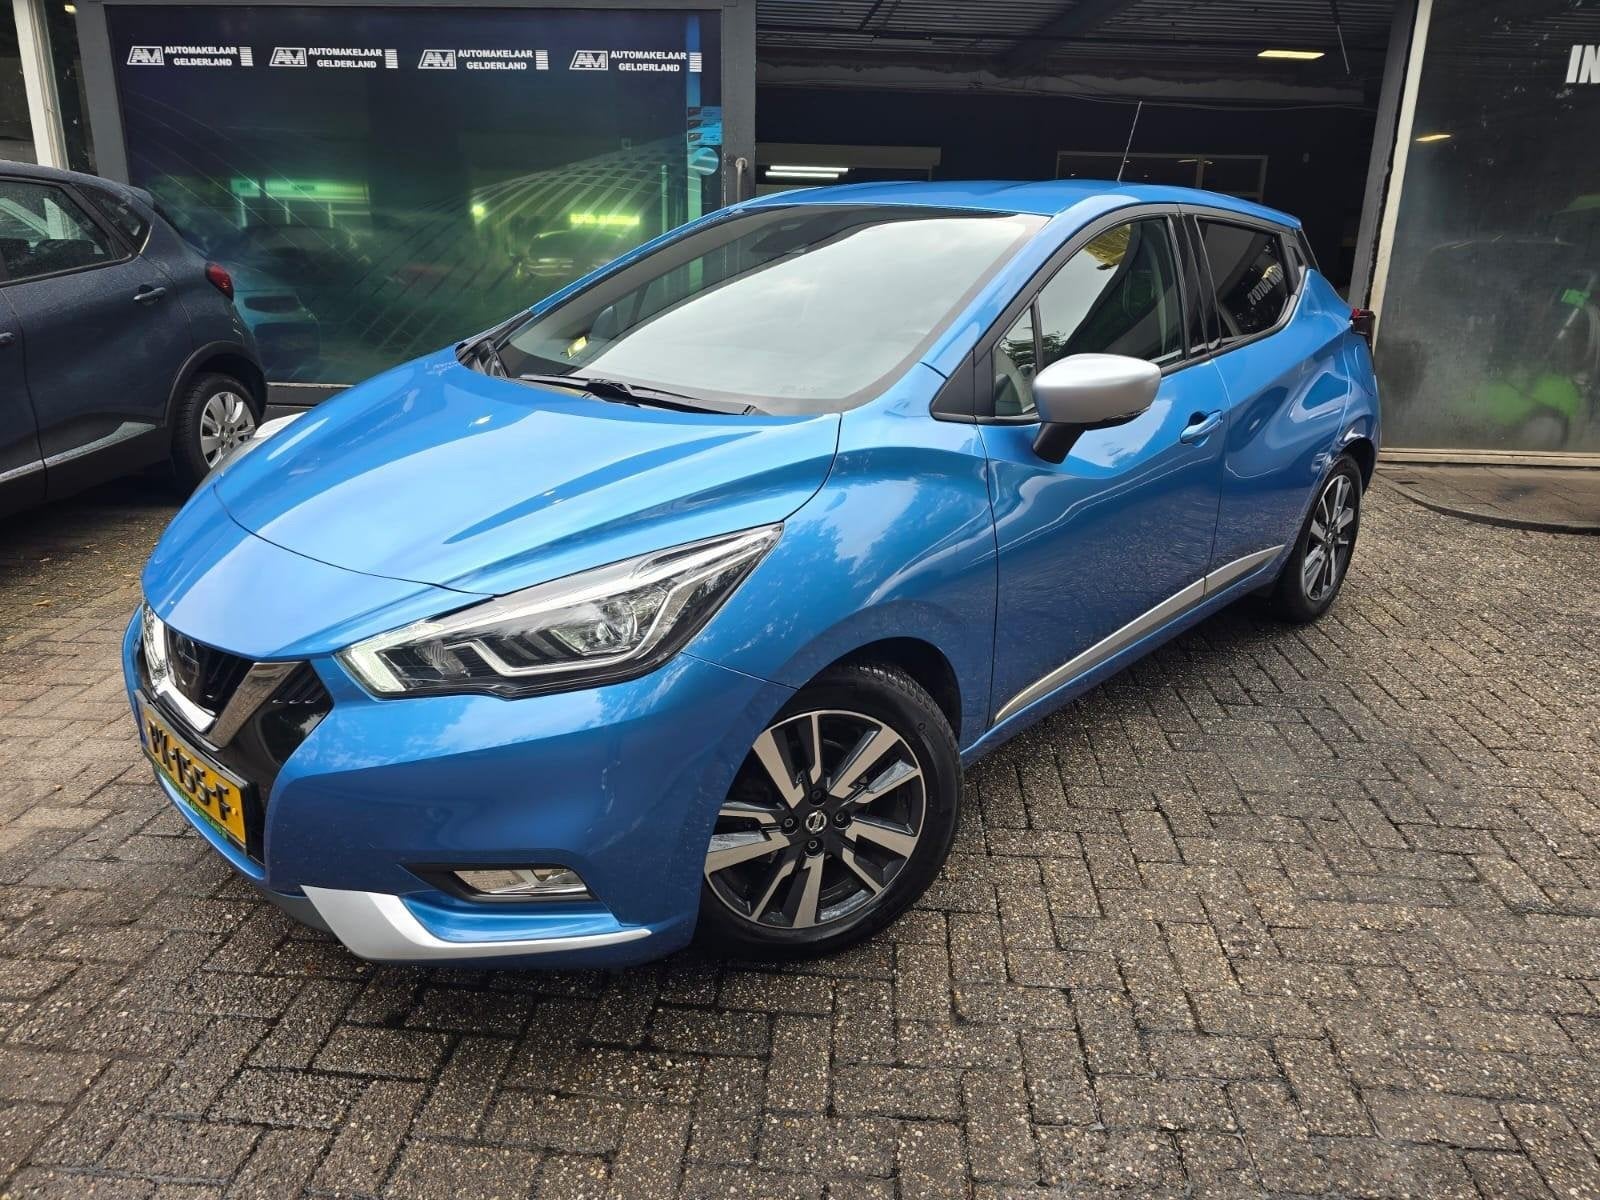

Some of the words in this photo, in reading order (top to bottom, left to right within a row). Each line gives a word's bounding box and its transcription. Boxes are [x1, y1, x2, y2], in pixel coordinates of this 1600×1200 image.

[130, 49, 163, 64] AM
[164, 46, 238, 55] AUTOMAKELAAR
[173, 57, 233, 67] GELDERLAND
[272, 50, 305, 65] AM
[308, 47, 383, 57] AUTOMAKELAAR
[421, 52, 456, 67] AM
[457, 49, 534, 59] AUTOMAKELAAR
[573, 53, 607, 68] AM
[610, 50, 687, 61] AUTOMAKELAAR
[316, 58, 377, 69] GELDERLAND
[466, 60, 528, 71] GELDERLAND
[618, 62, 681, 73] GELDERLAND
